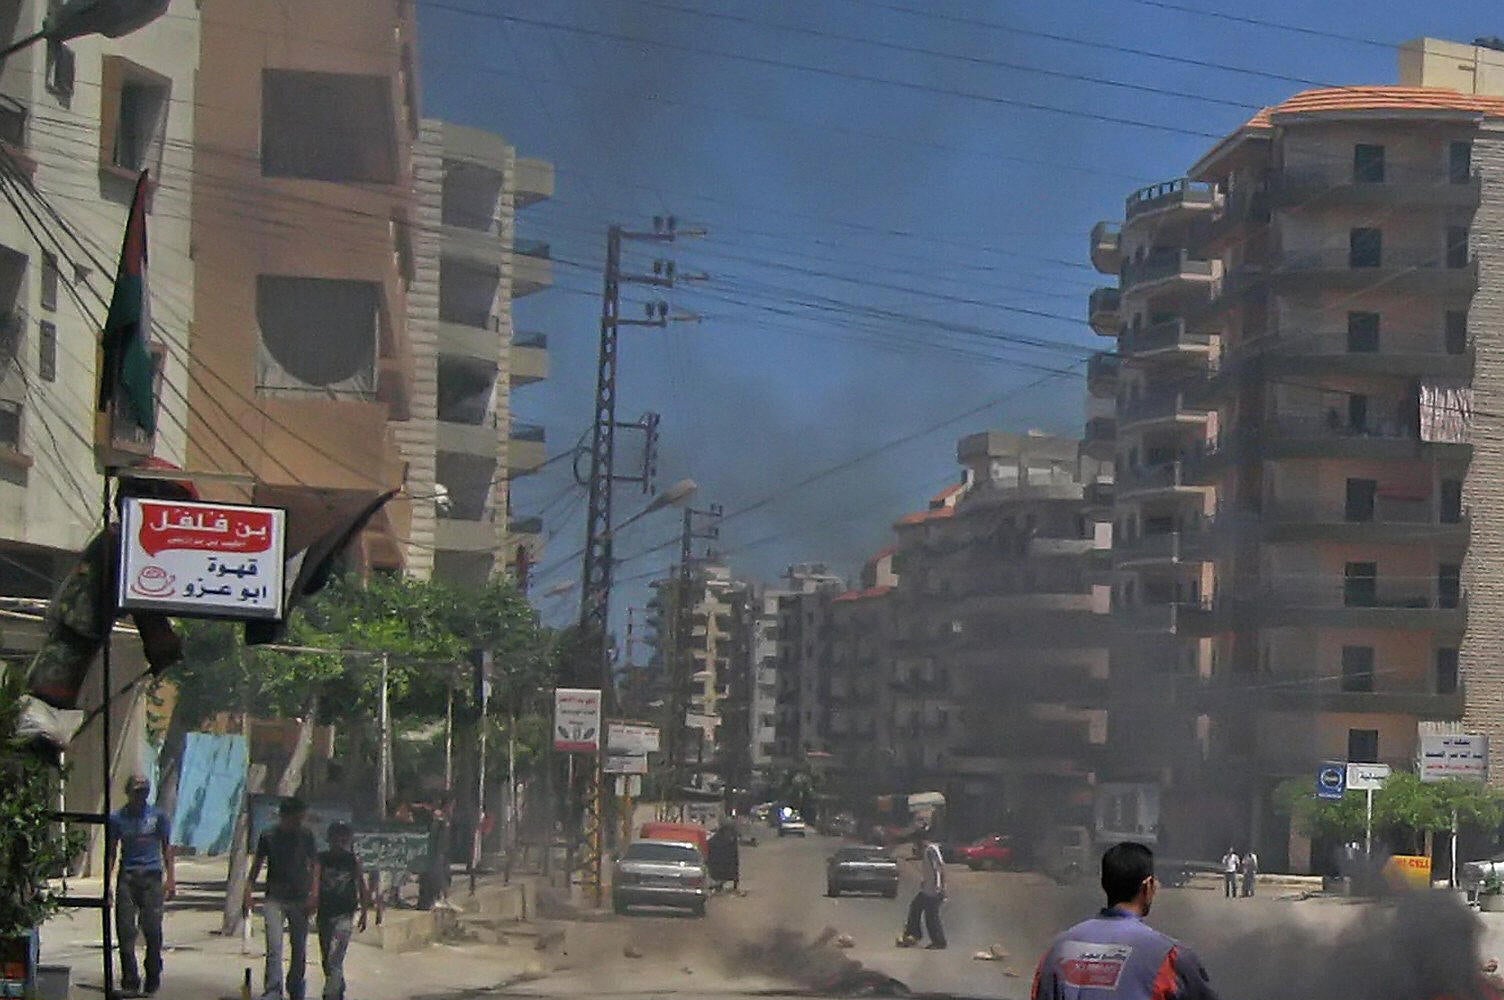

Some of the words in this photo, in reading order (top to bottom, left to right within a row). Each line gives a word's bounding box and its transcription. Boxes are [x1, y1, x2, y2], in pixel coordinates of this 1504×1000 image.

[235, 521, 267, 541] بن
[207, 557, 258, 579] قهوة
[182, 577, 232, 598] عزو
[236, 585, 267, 604] ابو
